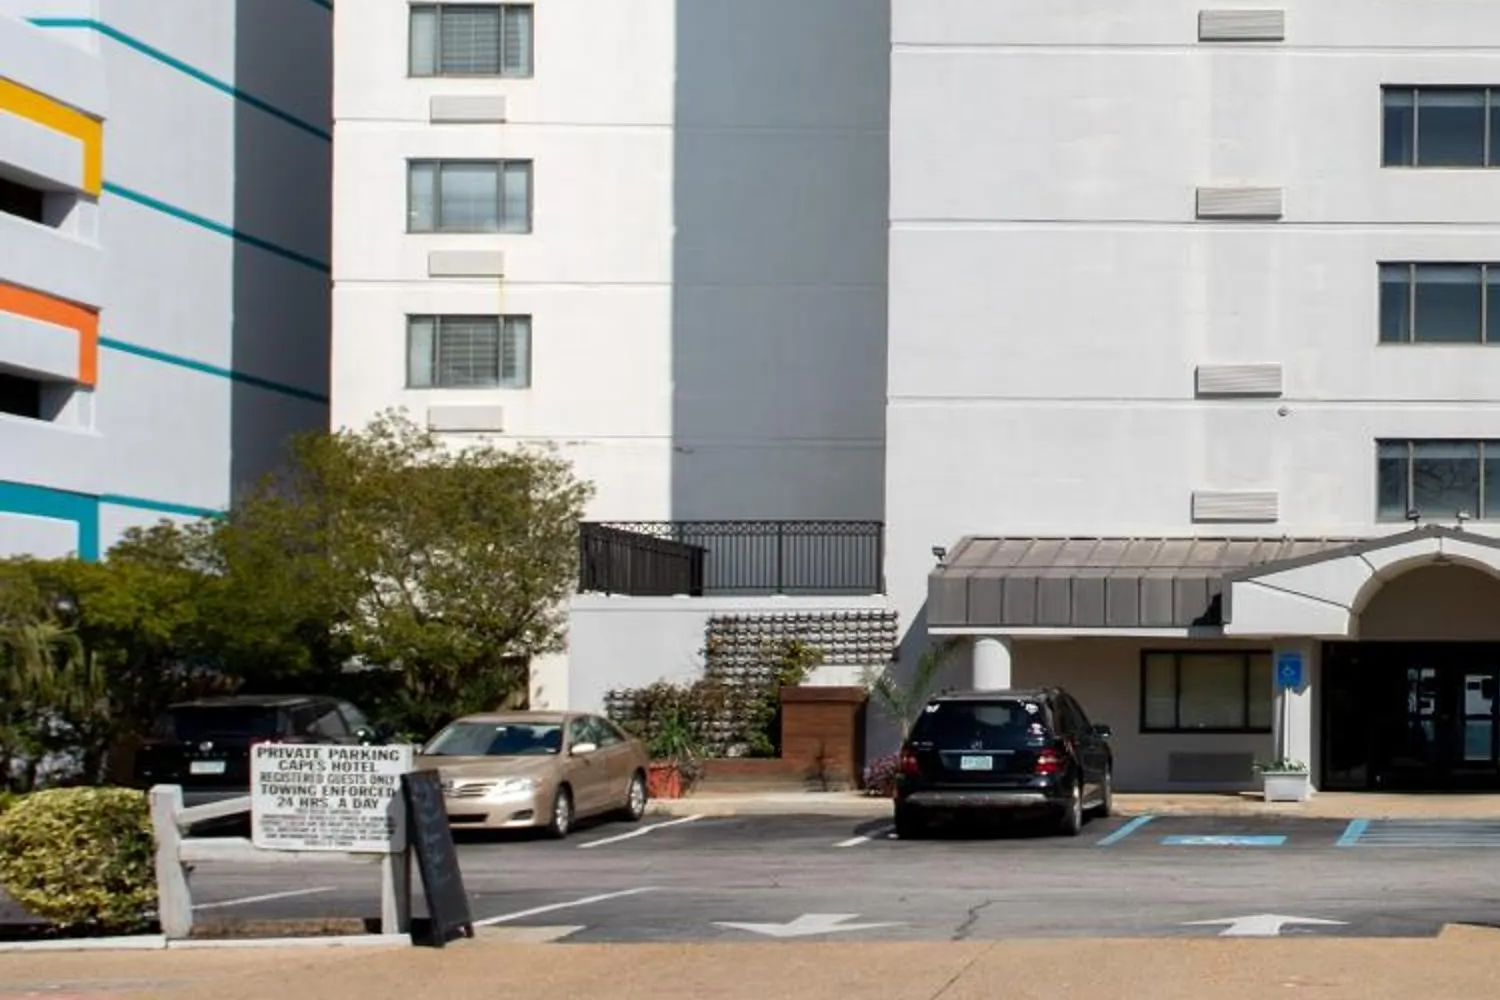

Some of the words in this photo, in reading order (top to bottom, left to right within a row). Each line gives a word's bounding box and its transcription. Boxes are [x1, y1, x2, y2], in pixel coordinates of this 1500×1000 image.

[257, 747, 321, 760] PRIVATE
[328, 748, 400, 761] PARKING
[278, 761, 326, 773] CAPES
[331, 762, 377, 773] HOTEL
[260, 772, 324, 784] REGISTERED
[327, 773, 367, 785] GUESTS
[369, 774, 395, 785] ONLY
[261, 784, 317, 797] TOWING
[322, 785, 396, 798] ENFORCED
[277, 797, 293, 808] 24
[338, 798, 347, 809] A
[353, 798, 379, 809] DAY
